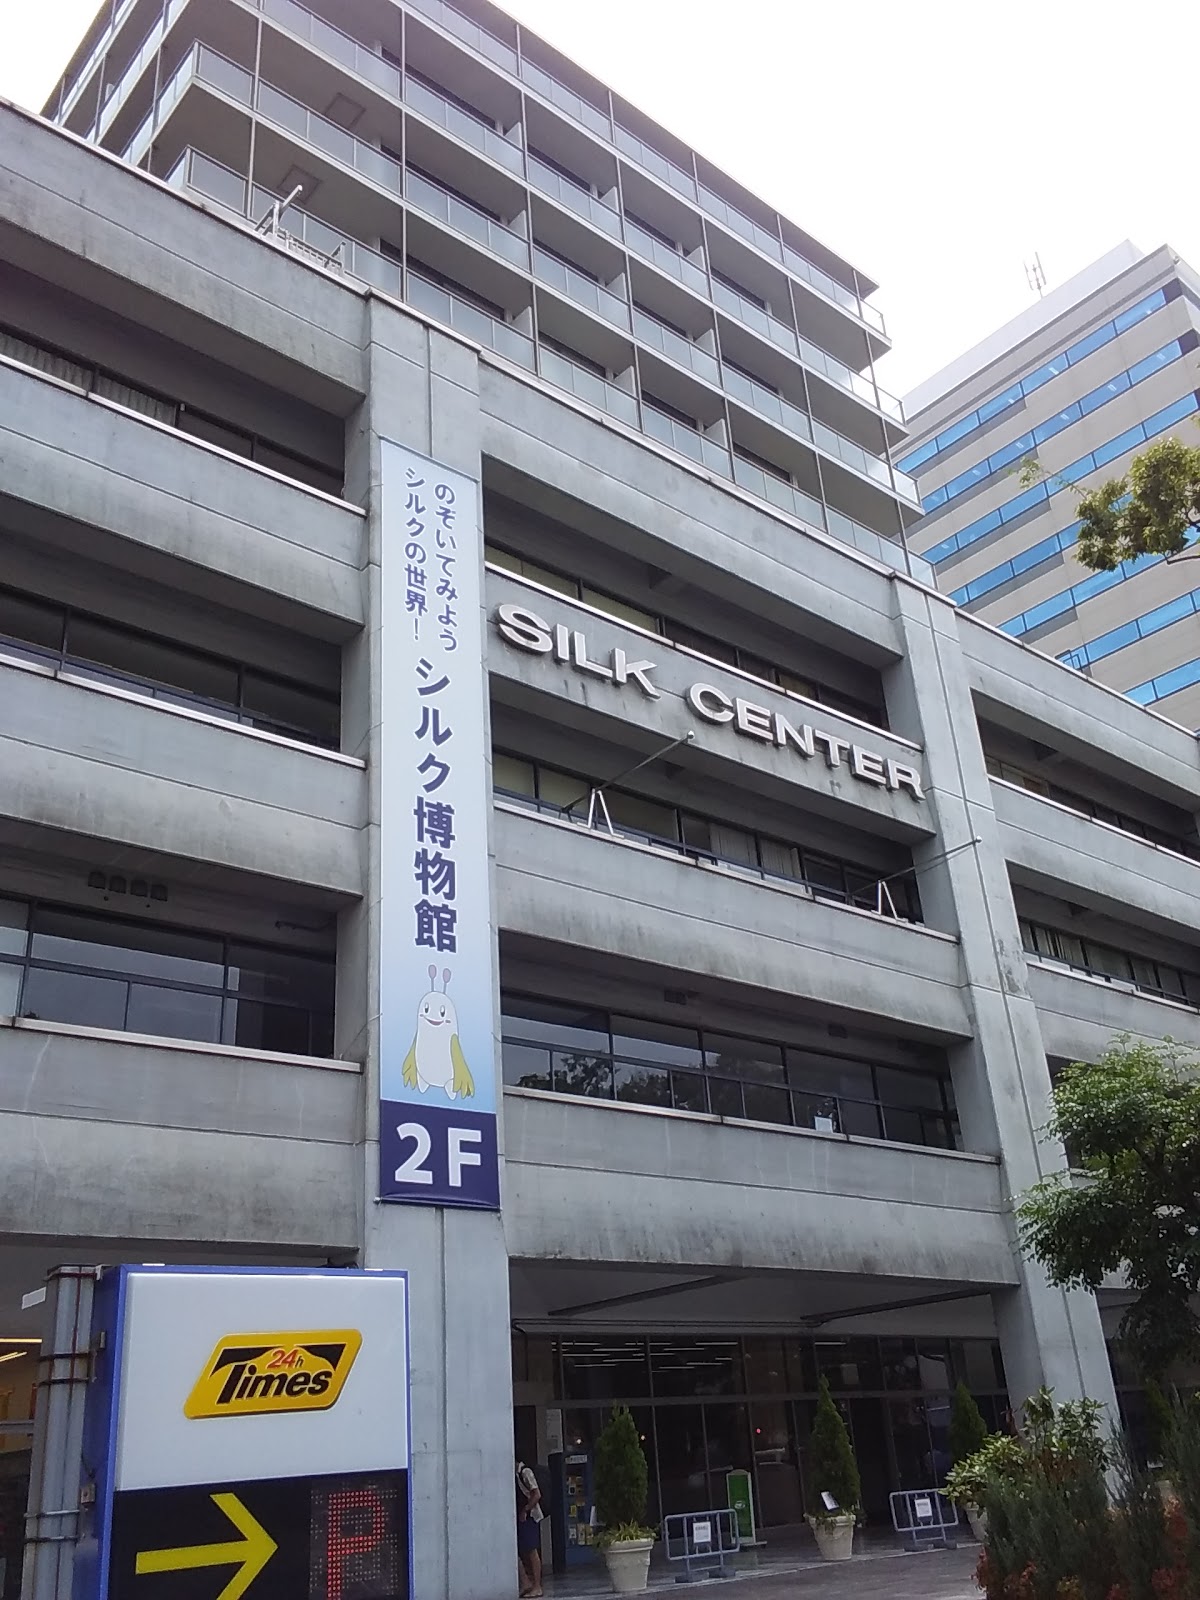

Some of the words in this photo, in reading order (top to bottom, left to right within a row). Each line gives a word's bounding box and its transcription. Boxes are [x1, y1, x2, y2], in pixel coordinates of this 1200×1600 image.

[434, 482, 458, 652] のぞいてみよう
[498, 604, 660, 698] SILK
[687, 683, 925, 801] CENTER
[414, 658, 457, 953] シルク博物館
[394, 1122, 483, 1188] 2F
[214, 1358, 332, 1404] Times
[266, 1349, 304, 1371] 24h
